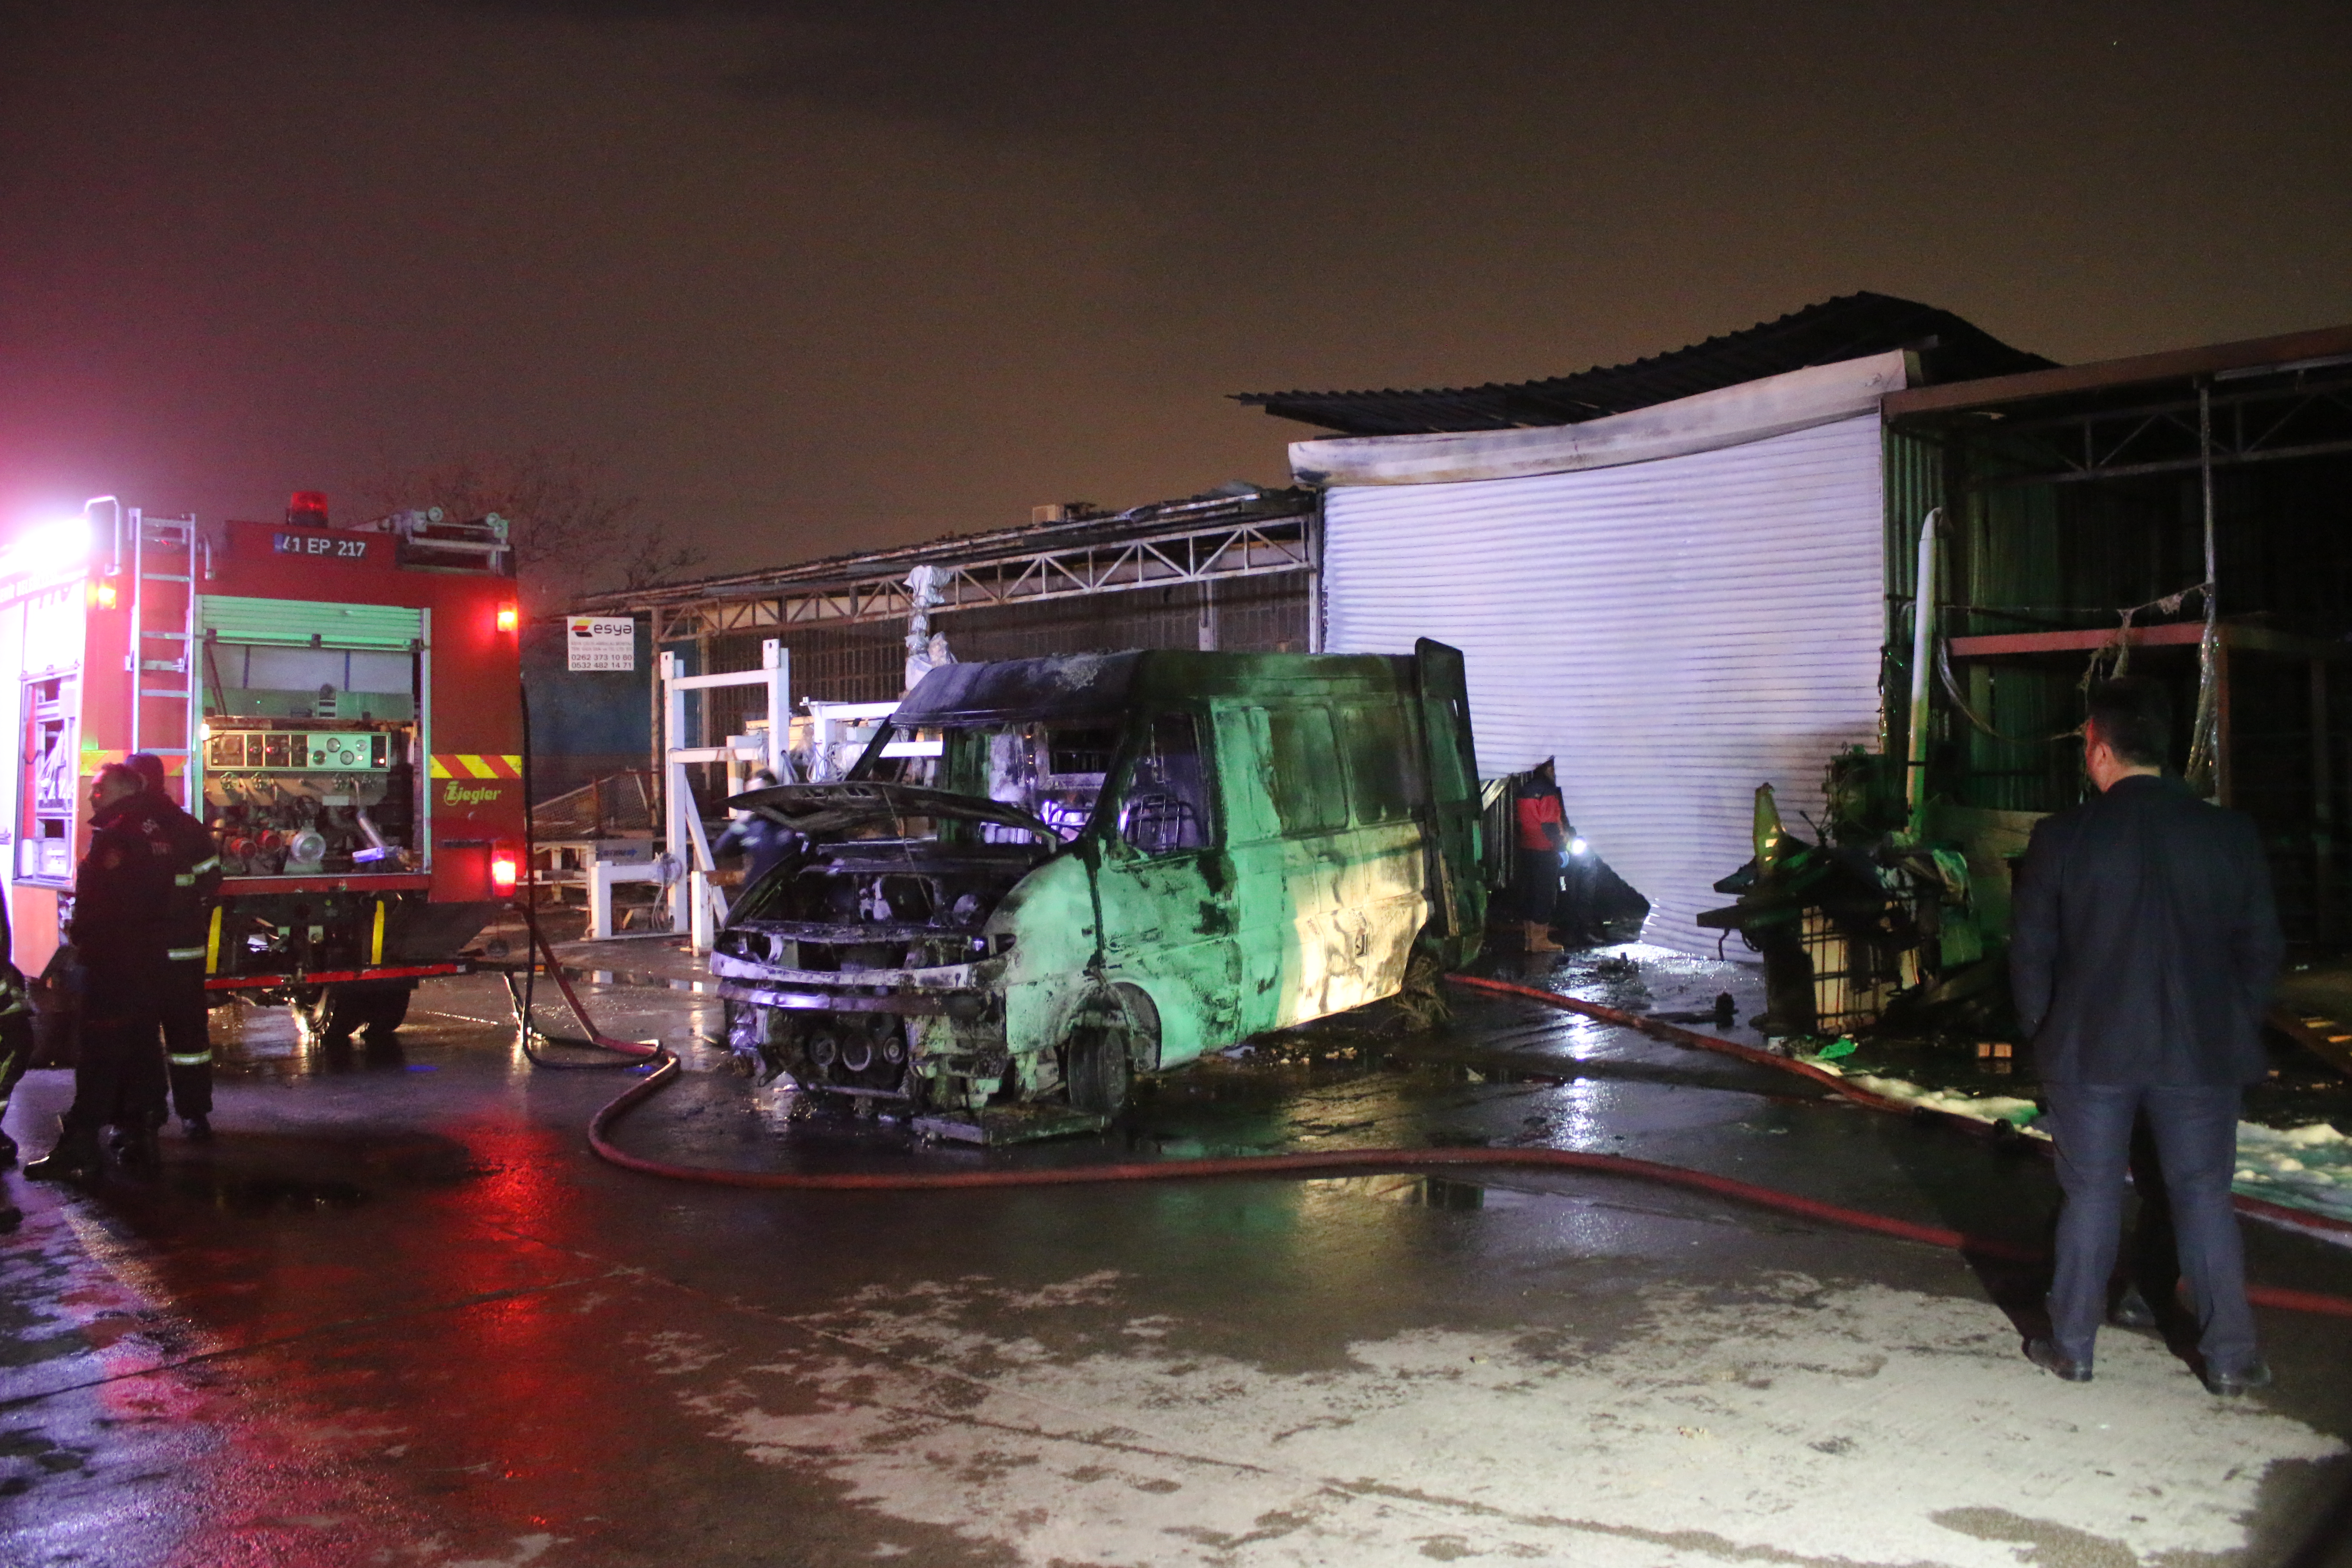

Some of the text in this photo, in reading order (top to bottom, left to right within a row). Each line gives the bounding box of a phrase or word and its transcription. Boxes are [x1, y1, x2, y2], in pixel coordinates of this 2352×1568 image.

[308, 538, 331, 554] EP
[338, 541, 366, 557] 217
[594, 624, 632, 636] esya
[444, 781, 502, 806] Ziegler
